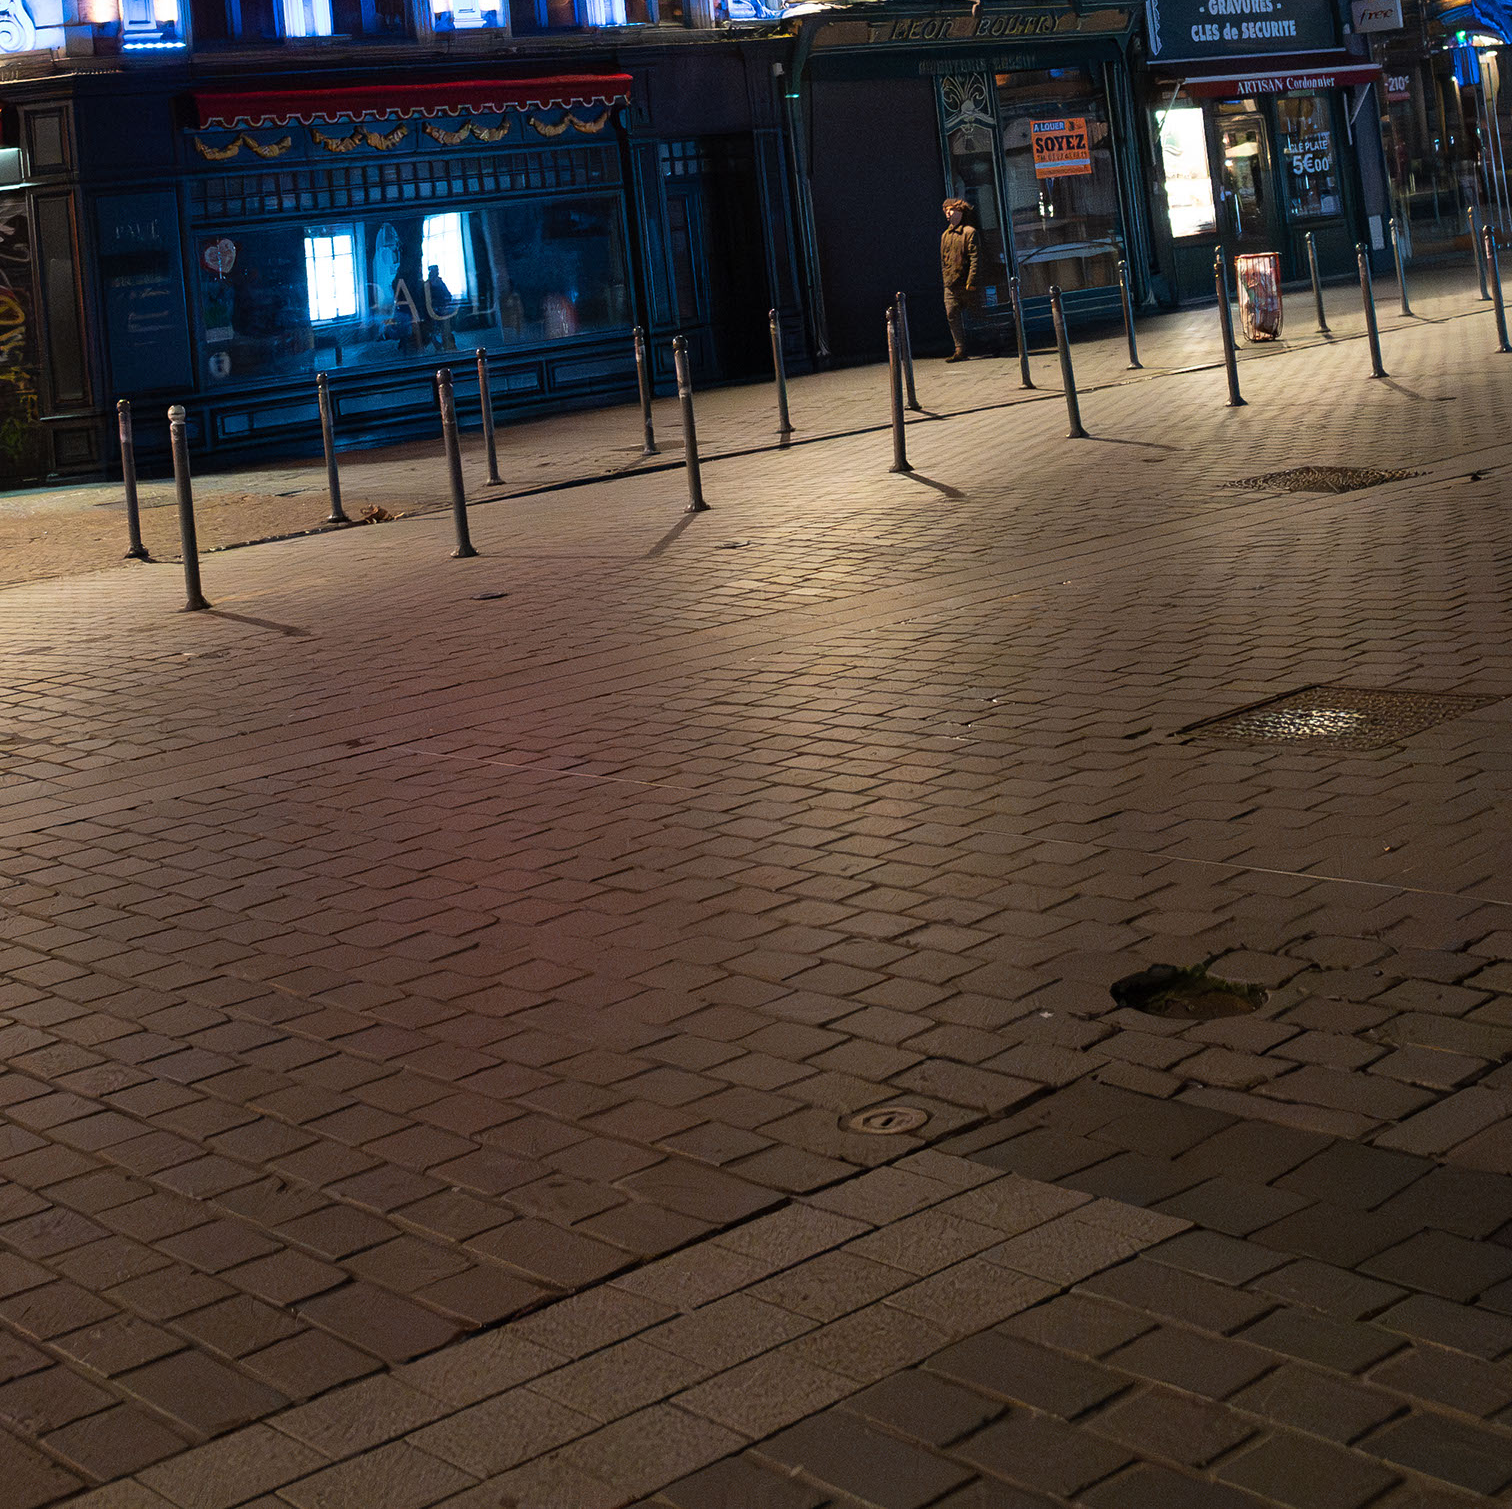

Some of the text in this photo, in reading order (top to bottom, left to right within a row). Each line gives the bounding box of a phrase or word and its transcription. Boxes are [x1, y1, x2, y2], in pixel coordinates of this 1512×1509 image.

[1359, 8, 1394, 26] free
[1191, 20, 1297, 42] CLES de SECURITE
[1236, 75, 1335, 95] ARTISAN Cordonnier
[1033, 121, 1065, 133] A LOUER
[1035, 134, 1086, 154] SOYEZ
